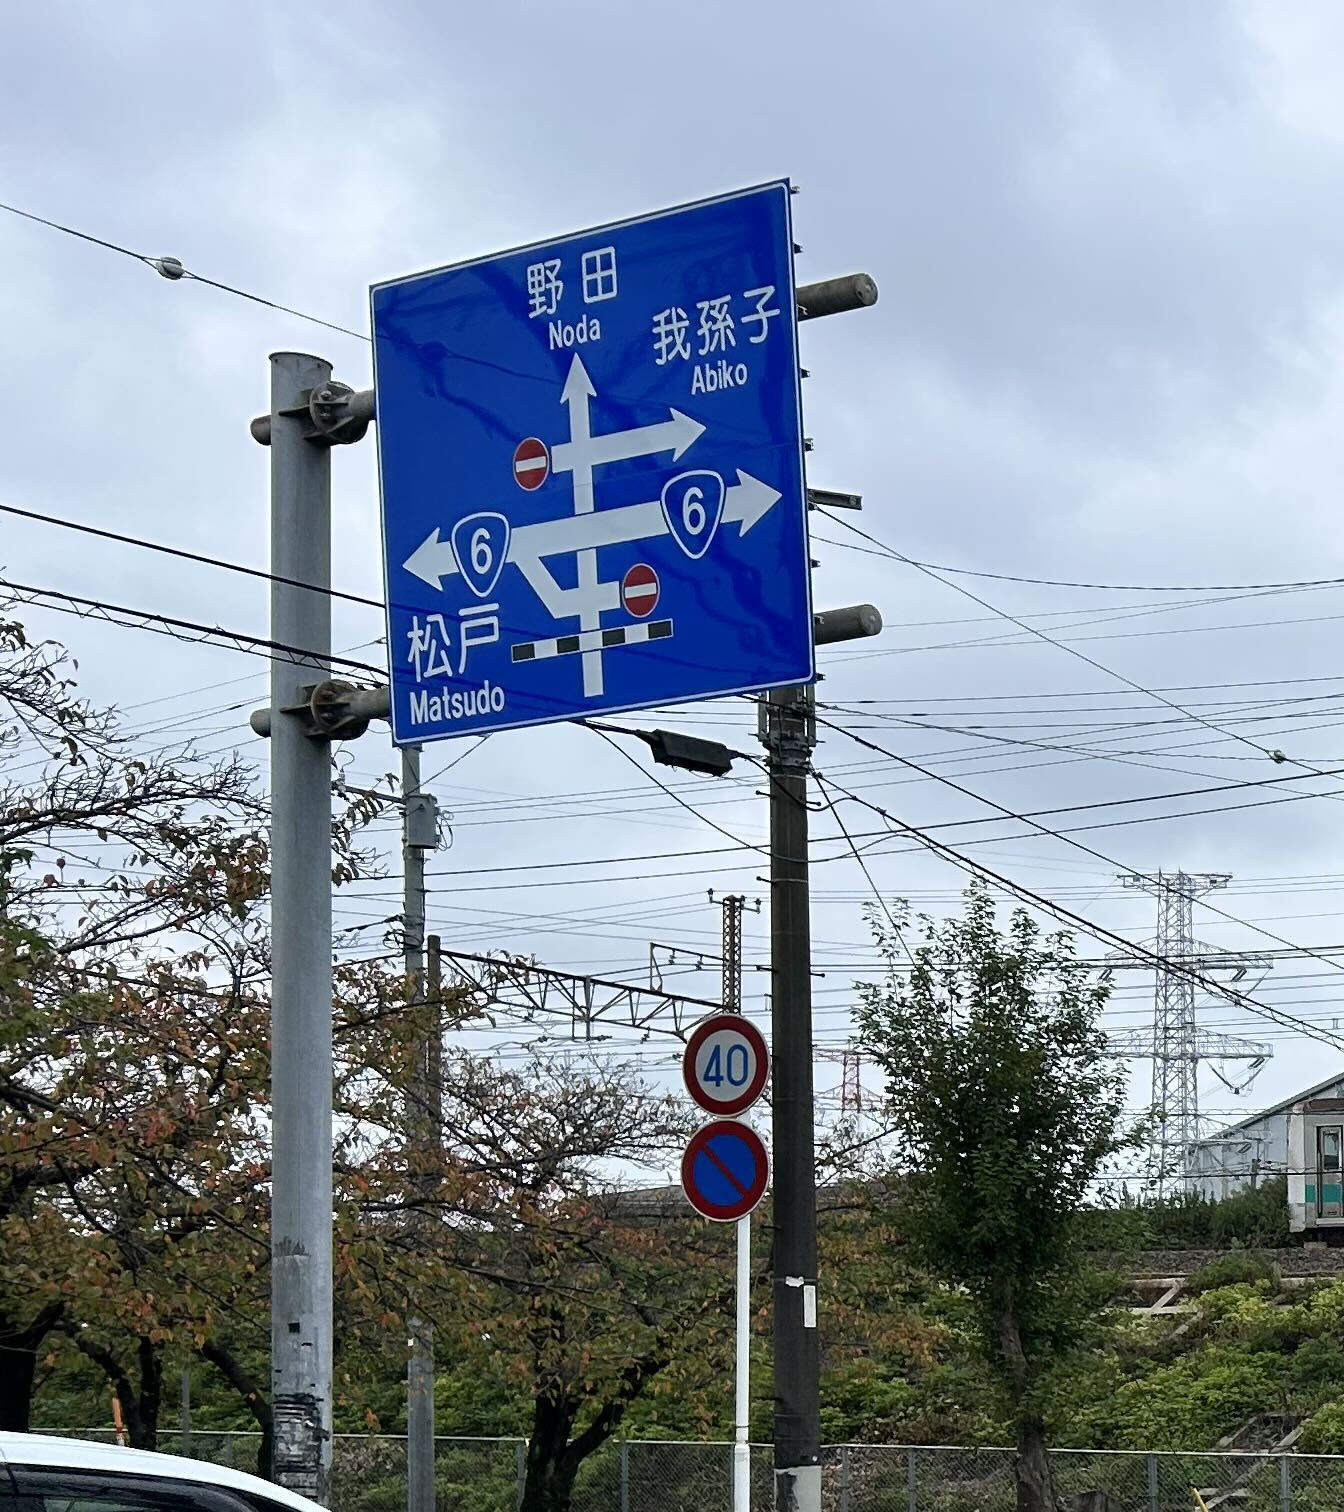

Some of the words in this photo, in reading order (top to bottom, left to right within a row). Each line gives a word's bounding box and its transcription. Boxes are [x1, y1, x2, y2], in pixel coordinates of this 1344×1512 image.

[527, 246, 618, 318] 野田
[549, 317, 601, 350] Noda
[652, 285, 781, 366] 我孫子
[691, 360, 748, 394] Abiko
[683, 484, 704, 535] 6
[471, 527, 492, 574] 6
[408, 603, 500, 682] 松戸
[410, 679, 505, 724] Matsudo
[703, 1044, 749, 1087] 40
